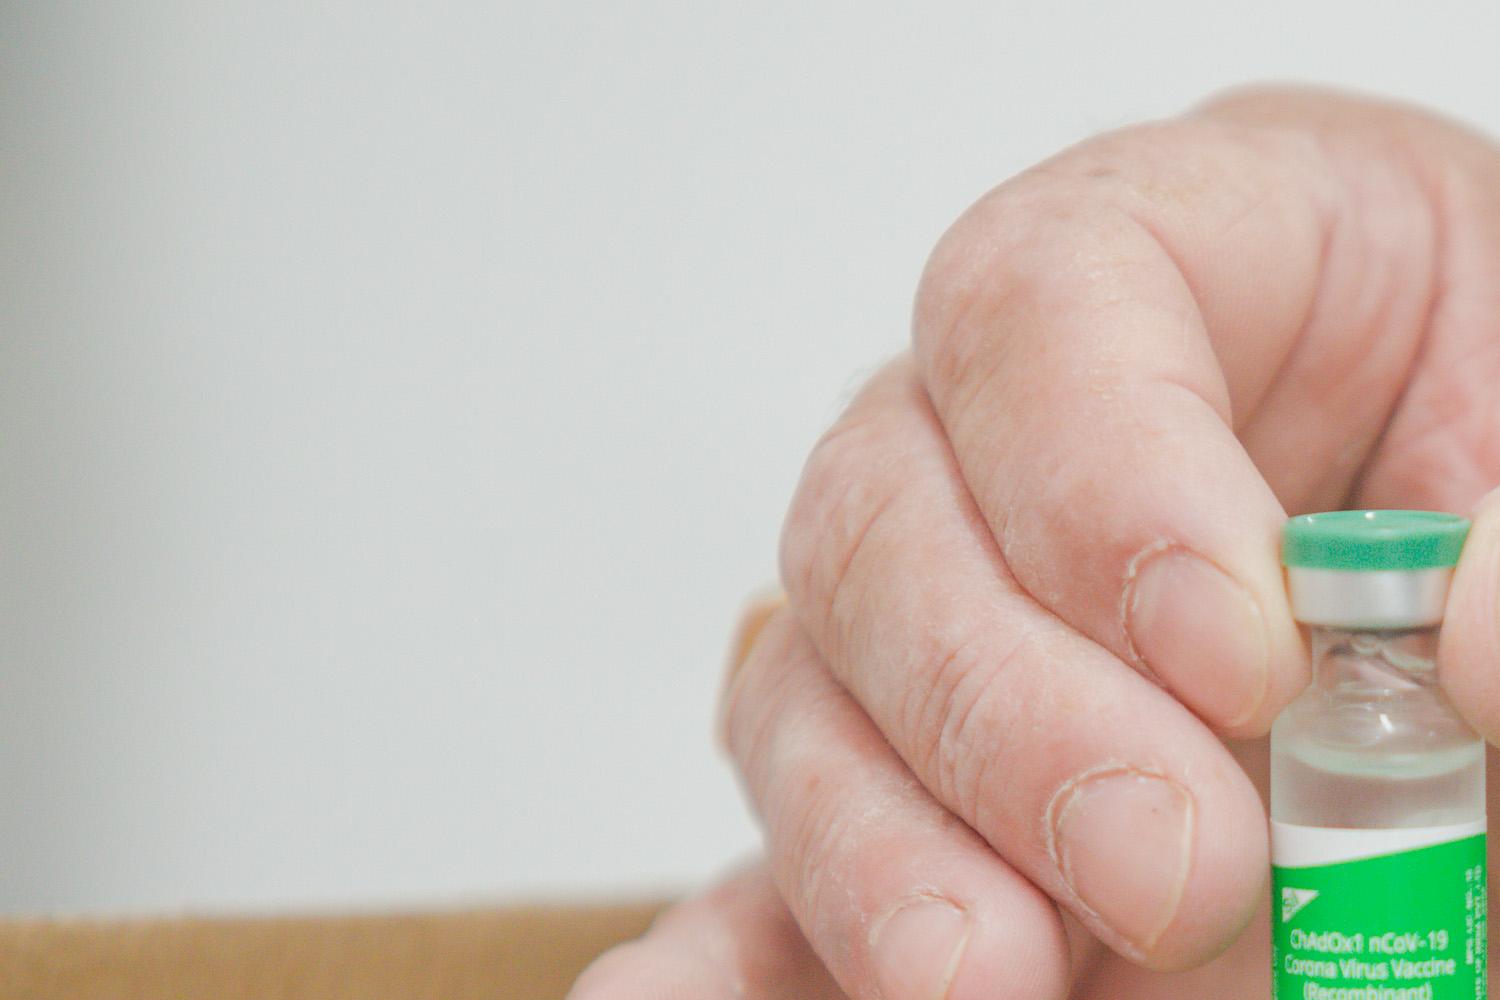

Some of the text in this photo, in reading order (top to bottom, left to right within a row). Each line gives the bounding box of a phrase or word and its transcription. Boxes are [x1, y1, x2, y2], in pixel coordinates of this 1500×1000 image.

[1290, 928, 1449, 953] ChAdOx1 nCoV-19
[1285, 954, 1456, 980] Corona Virus Vaccine
